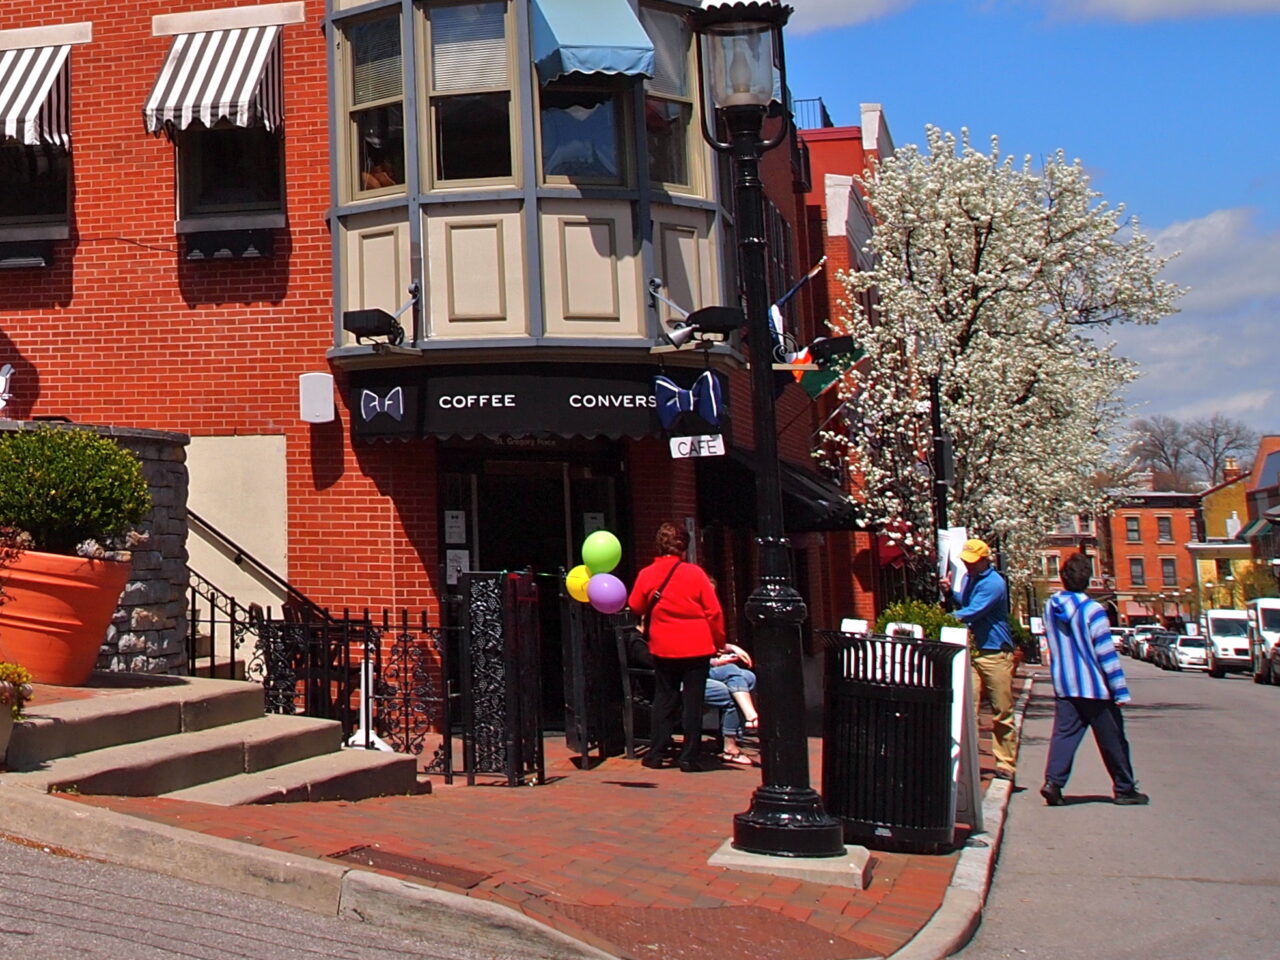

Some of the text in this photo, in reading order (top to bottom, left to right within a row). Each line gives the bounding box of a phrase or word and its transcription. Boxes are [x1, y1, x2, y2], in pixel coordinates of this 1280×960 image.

[438, 393, 516, 409] COFFEE
[569, 393, 657, 409] CONVERS
[677, 439, 718, 456] CAFE
